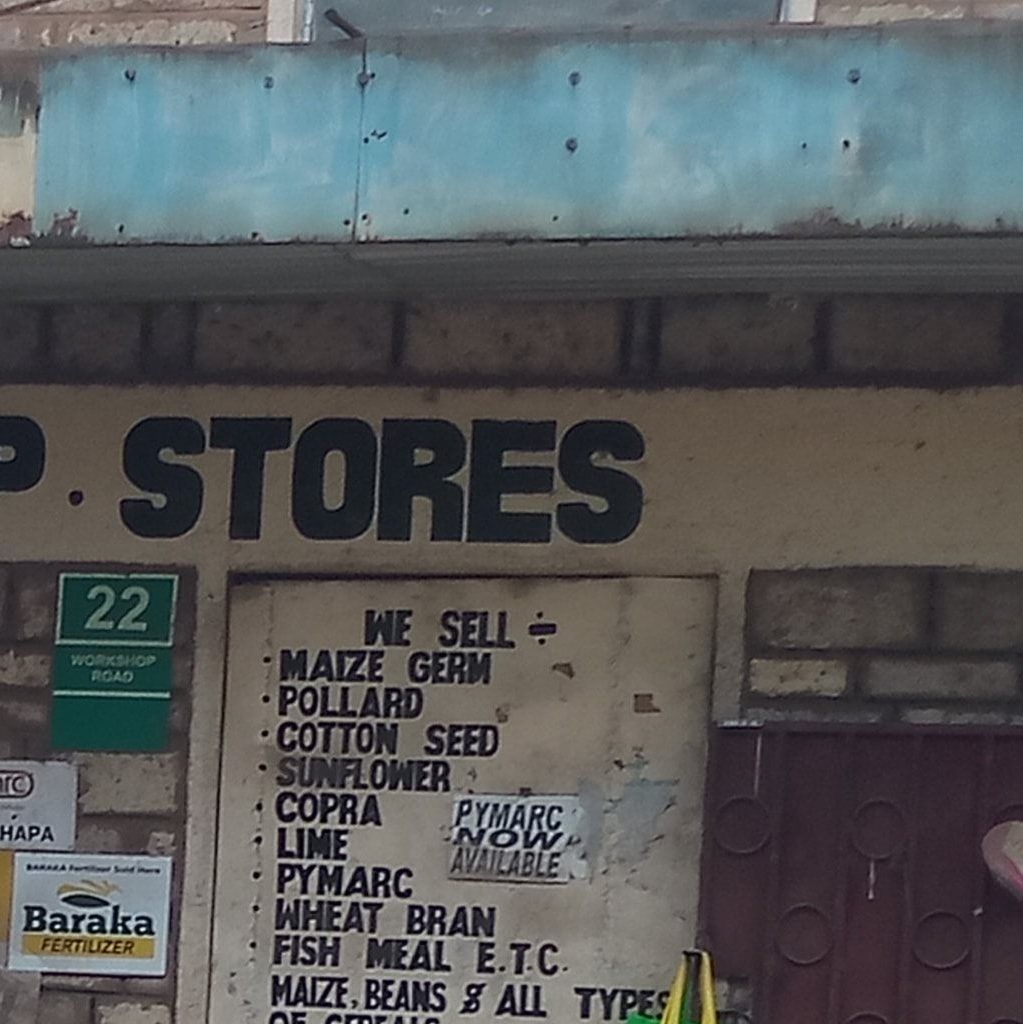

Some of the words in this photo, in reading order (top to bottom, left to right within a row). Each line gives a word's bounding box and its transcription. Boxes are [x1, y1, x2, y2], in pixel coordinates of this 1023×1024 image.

[119, 416, 647, 545] STORES
[84, 585, 150, 631] 22
[364, 609, 413, 646] WE
[439, 610, 516, 648] SELL
[70, 654, 157, 668] WORKSHOP
[91, 669, 134, 683] ROAD
[279, 650, 385, 682] MAIZE
[407, 652, 492, 684] GERM
[278, 686, 424, 719] POLLARD
[277, 721, 399, 754] COTTON
[423, 724, 499, 757] SEED
[276, 757, 451, 792] SUNFLOWER
[275, 792, 382, 825] COPRA
[455, 799, 563, 831] PYMARC
[0, 825, 55, 843] HAPA
[277, 829, 348, 860] LIME
[453, 828, 564, 850] NOW
[450, 848, 561, 878] AVAILABLE
[276, 864, 413, 899] PYMARC
[23, 905, 155, 936] Baraka
[274, 899, 383, 934] WHEAT
[407, 906, 496, 937] BRAN
[41, 938, 135, 955] FERTILIZER
[273, 937, 340, 967] FISH
[365, 939, 451, 972] MEAL
[364, 979, 446, 1012] BEANS
[495, 985, 547, 1017] ALL
